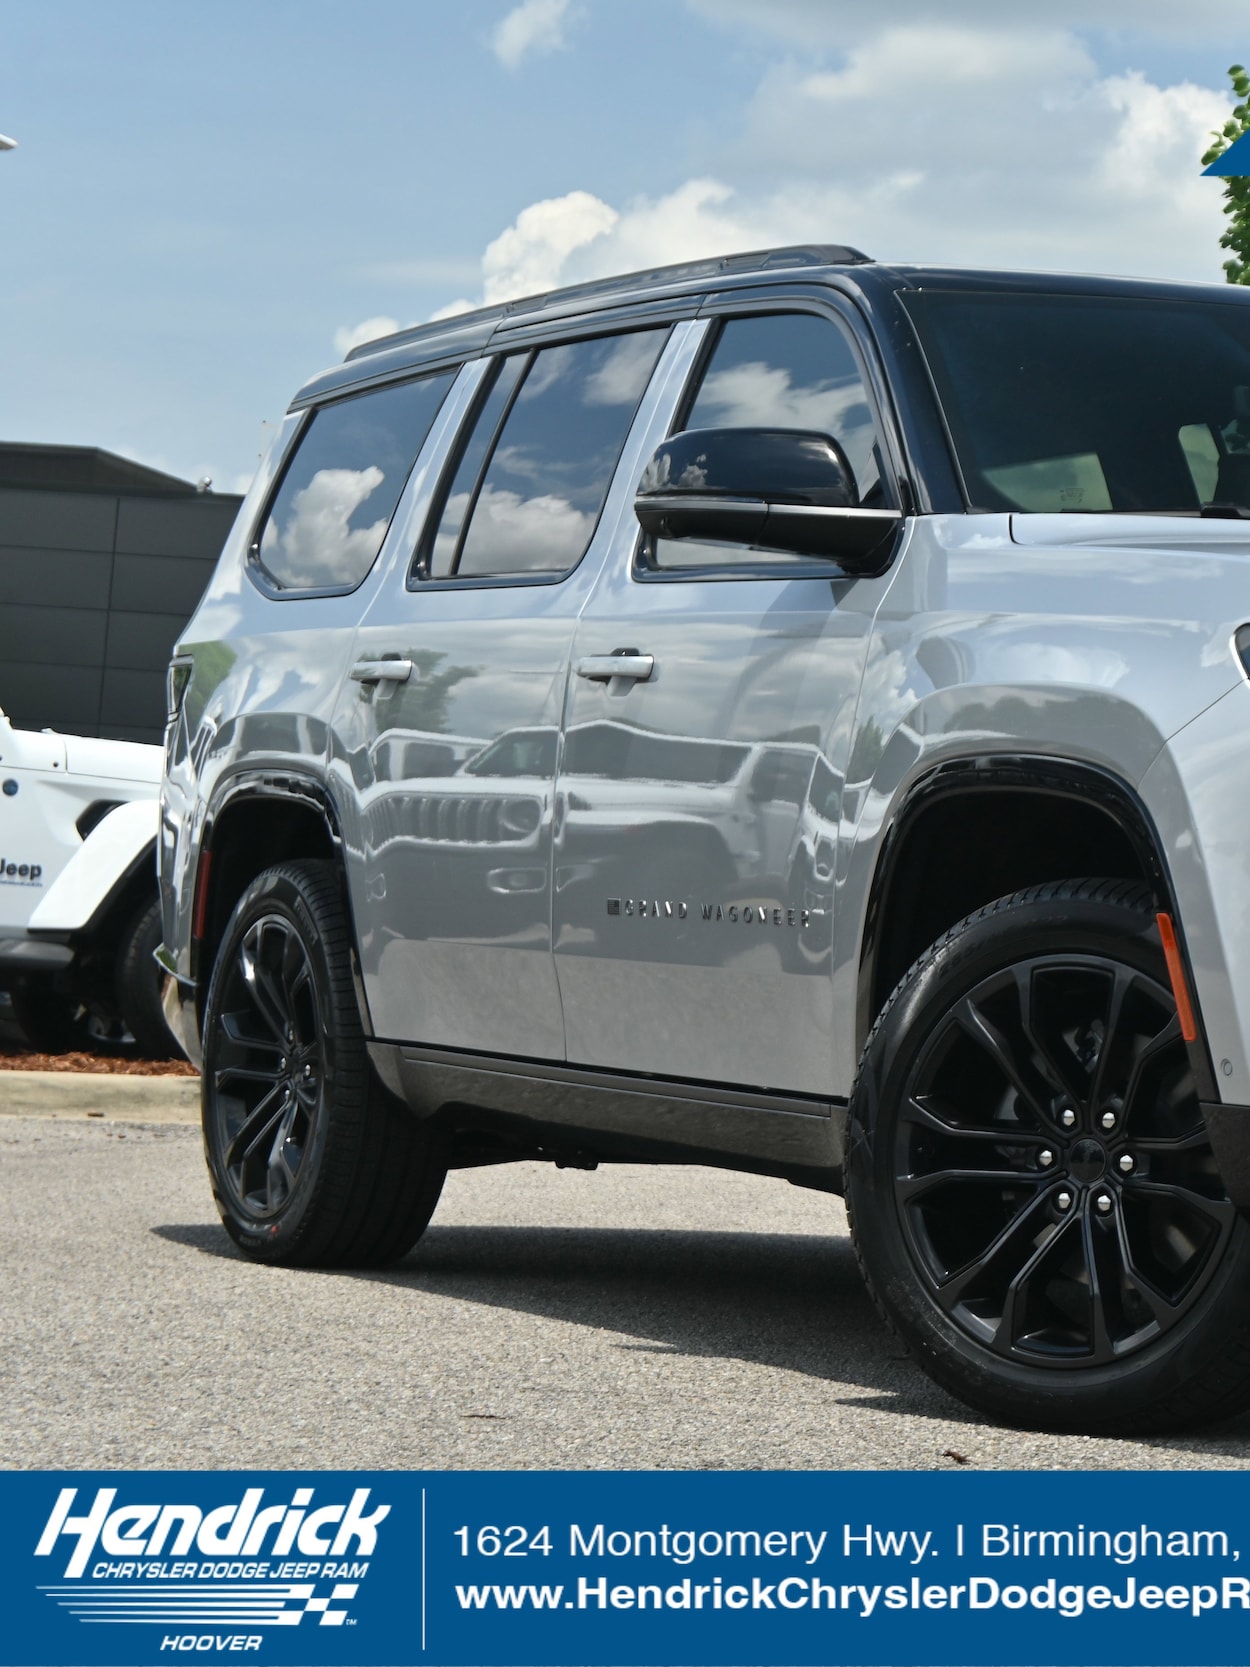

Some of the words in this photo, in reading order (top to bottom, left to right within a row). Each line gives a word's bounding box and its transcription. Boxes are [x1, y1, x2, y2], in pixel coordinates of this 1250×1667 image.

[0, 858, 42, 880] Jeep
[624, 899, 688, 919] GRAND
[701, 903, 810, 928] WAGONEER
